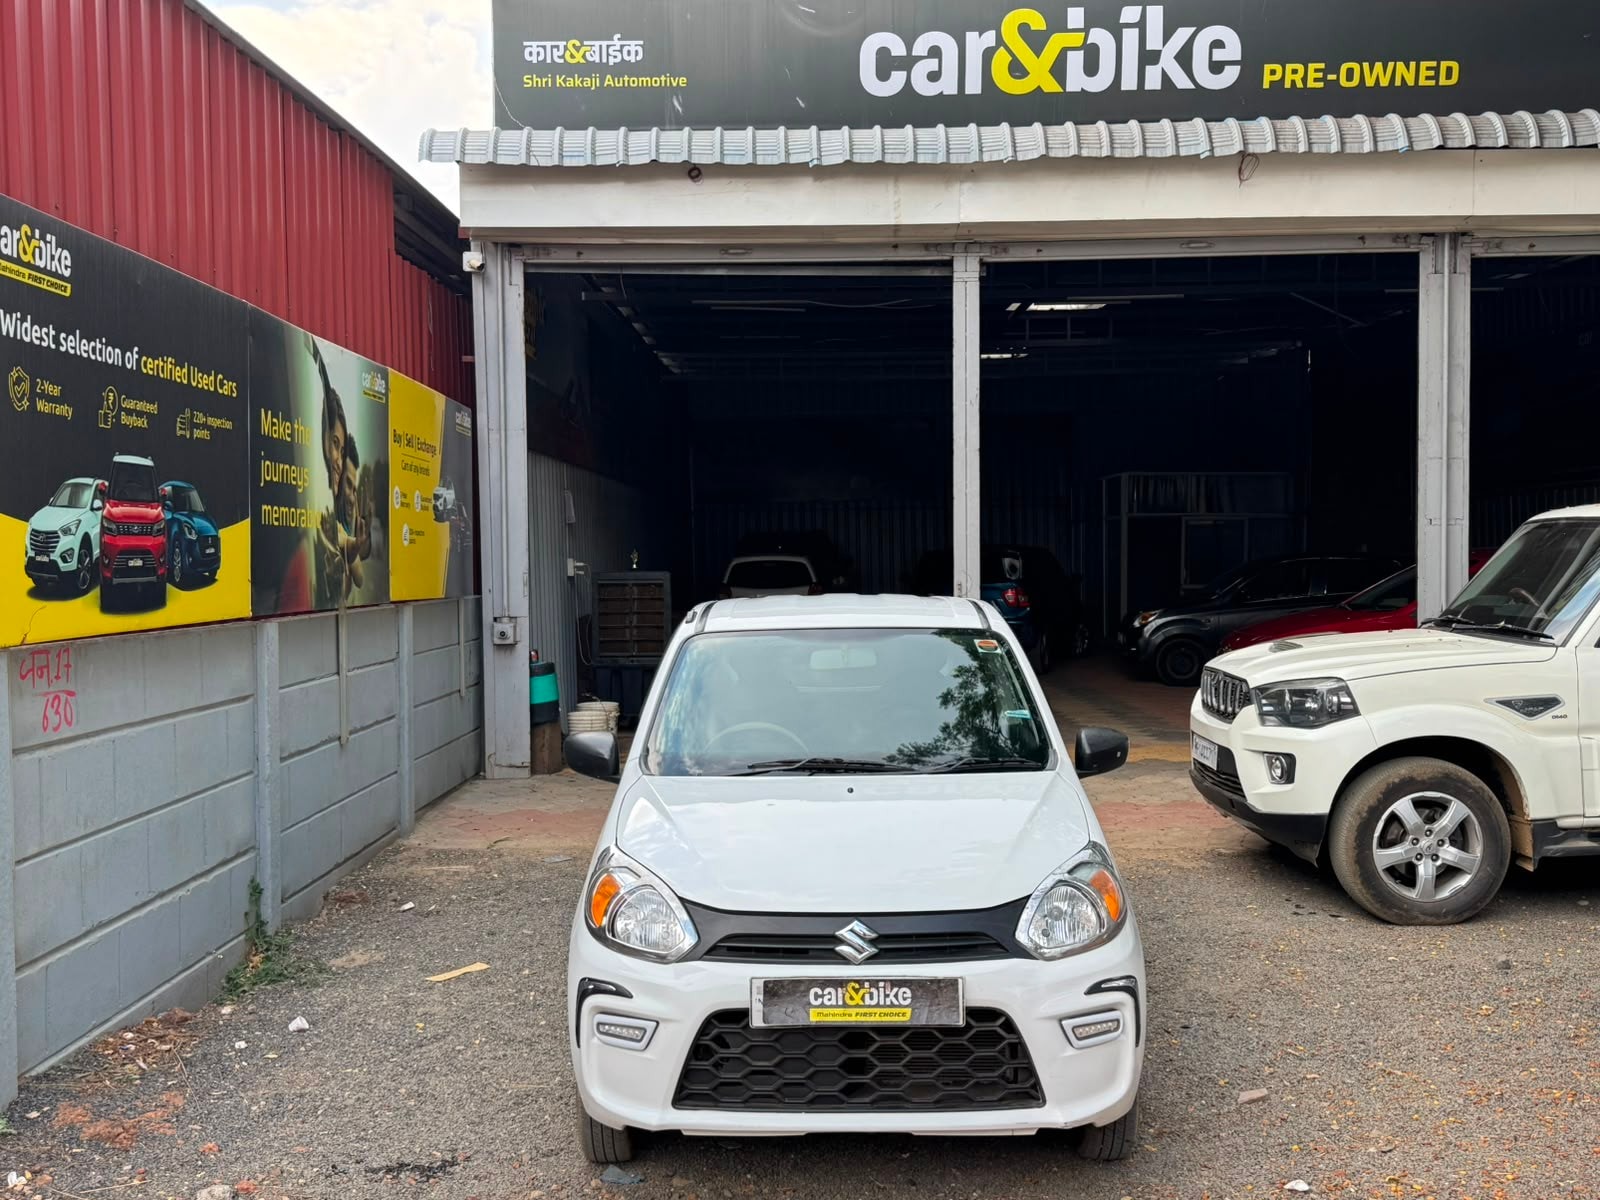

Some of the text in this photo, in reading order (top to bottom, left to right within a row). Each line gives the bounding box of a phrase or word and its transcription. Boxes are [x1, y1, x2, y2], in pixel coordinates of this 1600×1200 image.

[522, 33, 644, 66] कार&बाईक
[859, 5, 1242, 97] car&bike
[522, 73, 688, 90] Shri Kakaji Automotive
[1262, 60, 1460, 90] PRE-OWNED
[0, 223, 72, 278] ar&bike
[0, 262, 69, 294] ahindra FIRST CHOICE
[0, 308, 238, 398] Widest selection of certified Used Cars
[36, 378, 62, 397] 2-Year
[36, 397, 74, 421] Warranty
[120, 394, 159, 415] Guaranteed
[120, 411, 149, 429] Buyback
[193, 426, 211, 441] points
[206, 412, 233, 431] inspection
[260, 407, 292, 443] Make
[393, 428, 403, 449] Buy
[417, 436, 438, 459] Exchange
[260, 450, 311, 494] journeys
[42, 694, 74, 733] 630
[808, 982, 913, 1006] car&bike
